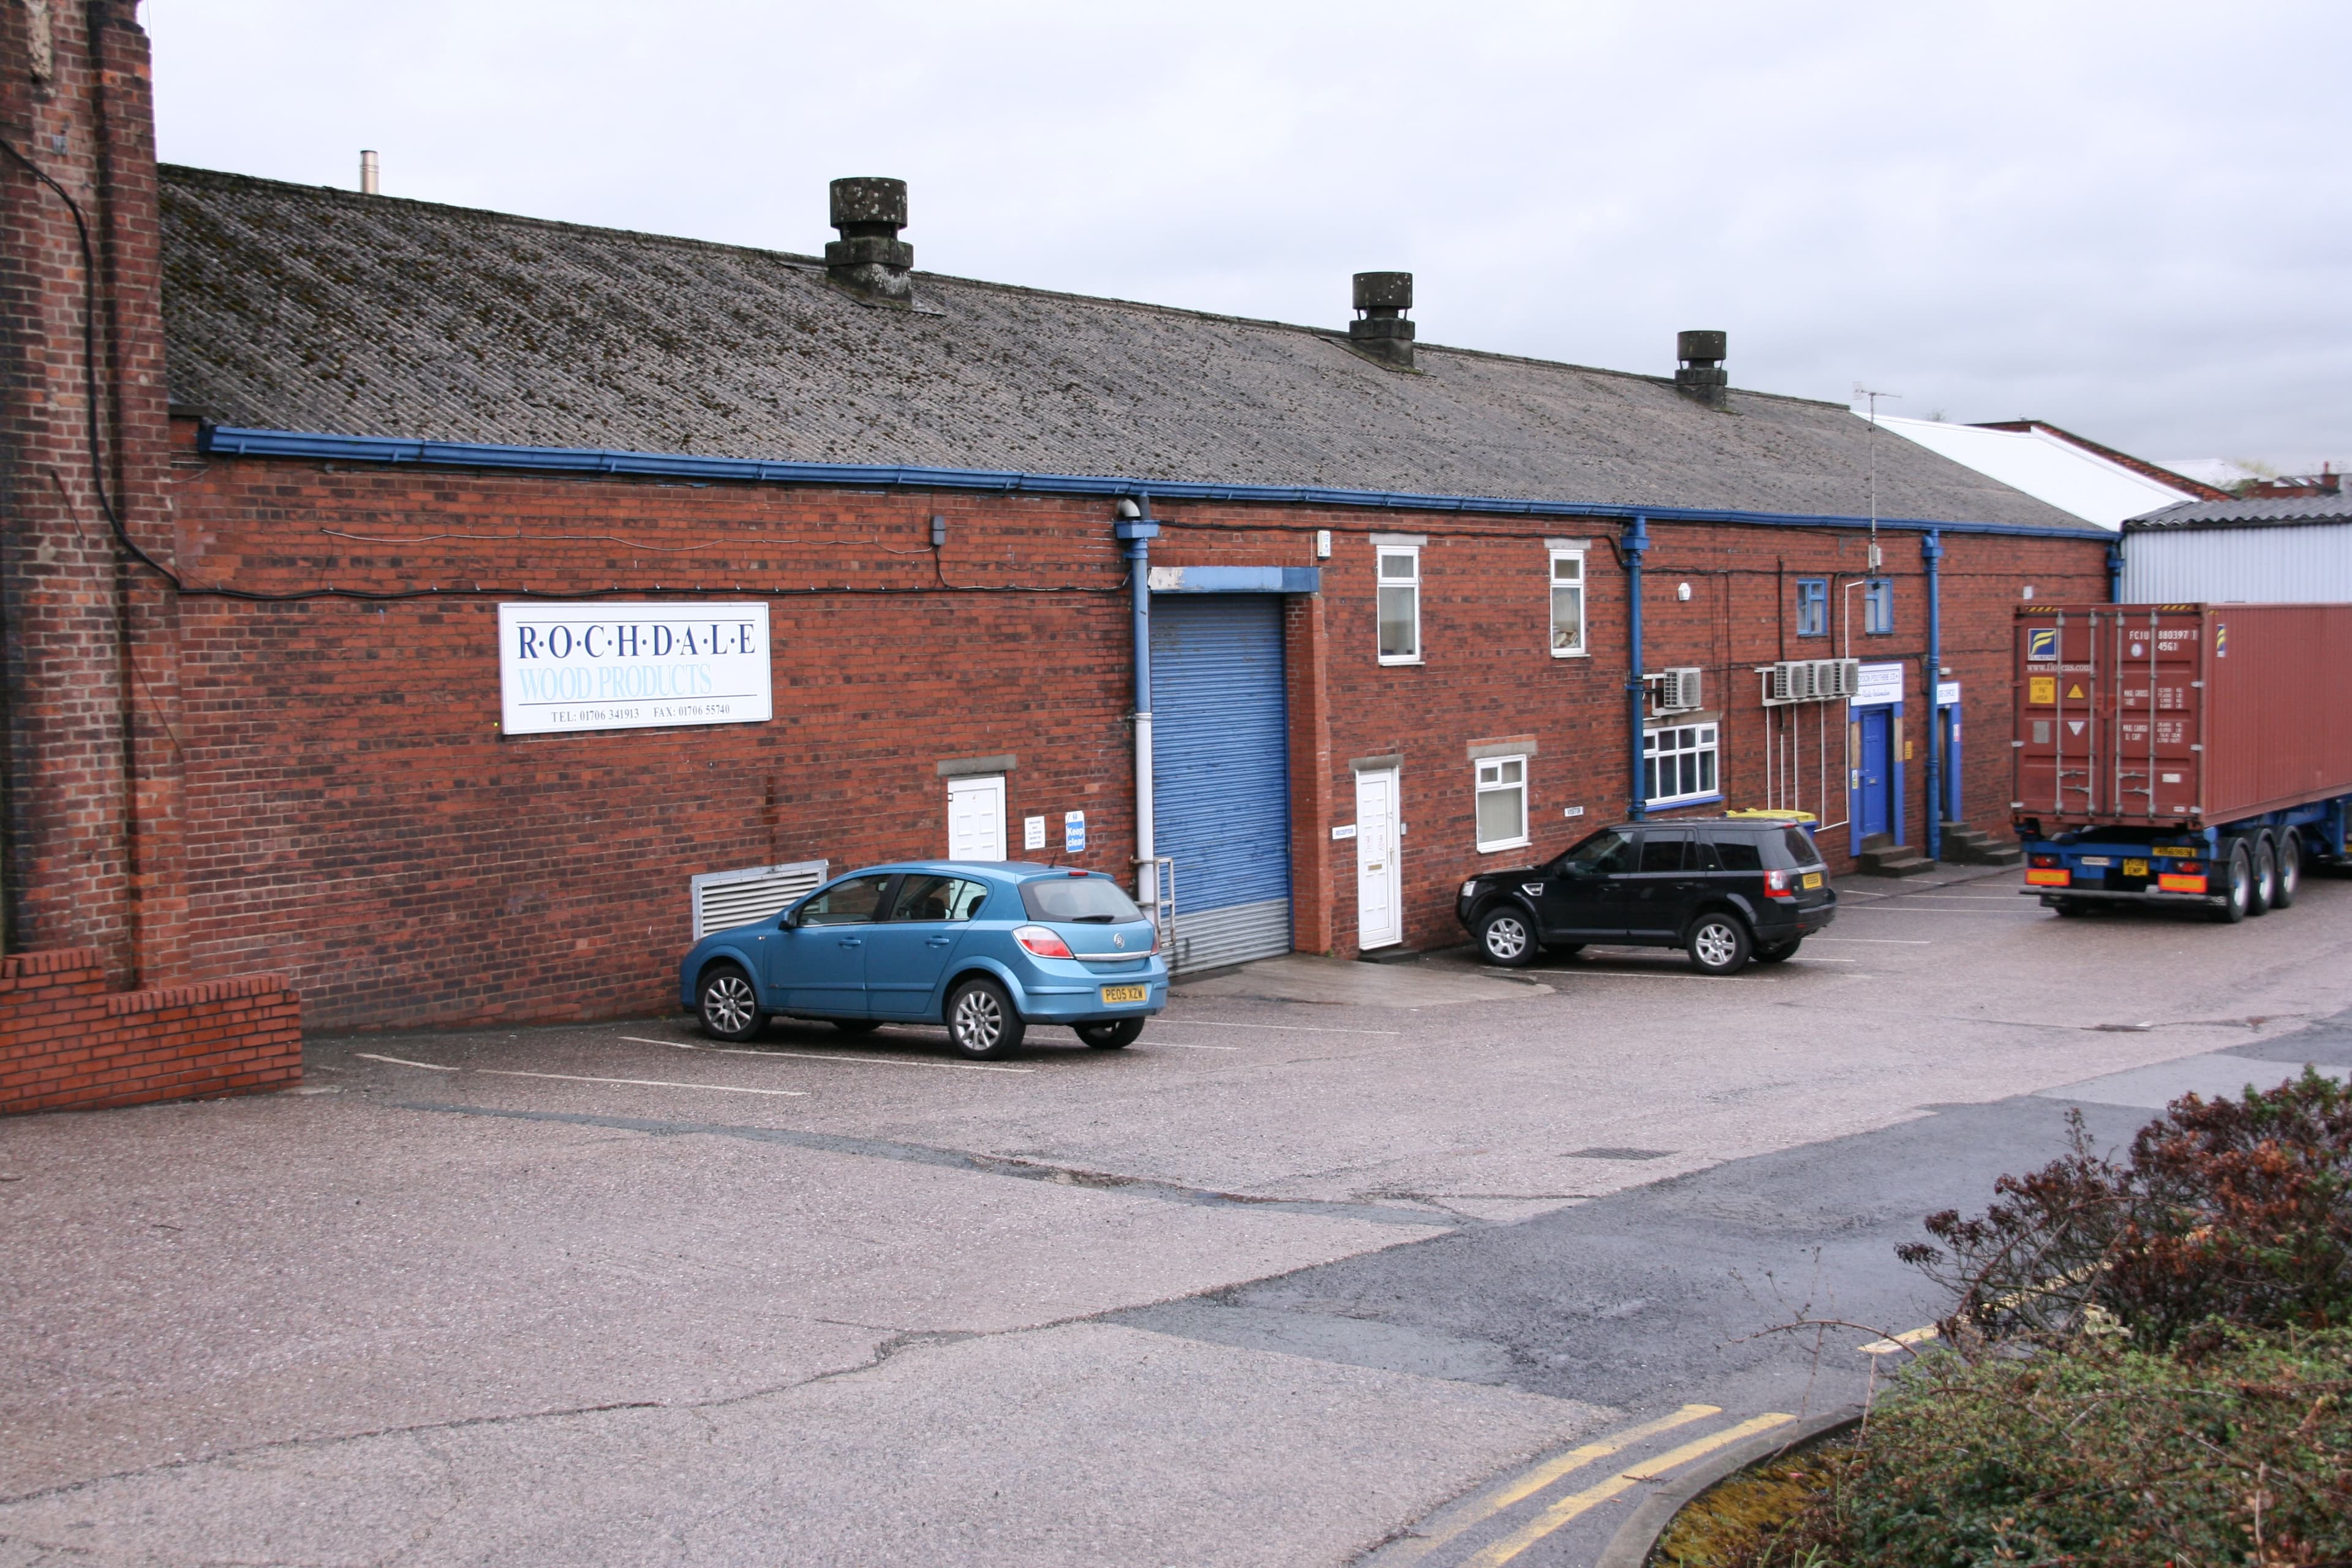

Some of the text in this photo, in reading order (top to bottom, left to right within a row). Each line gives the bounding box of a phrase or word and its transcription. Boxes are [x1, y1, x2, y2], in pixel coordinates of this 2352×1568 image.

[2157, 630, 2188, 639] 880397
[519, 663, 712, 701] WOOD PRODUCTS
[551, 704, 730, 723] TEL: 01706 341913 FAX: 01706 55740
[1068, 827, 1084, 837] Keep
[1068, 837, 1084, 847] clear
[1106, 987, 1143, 1000] PE05 XZW
